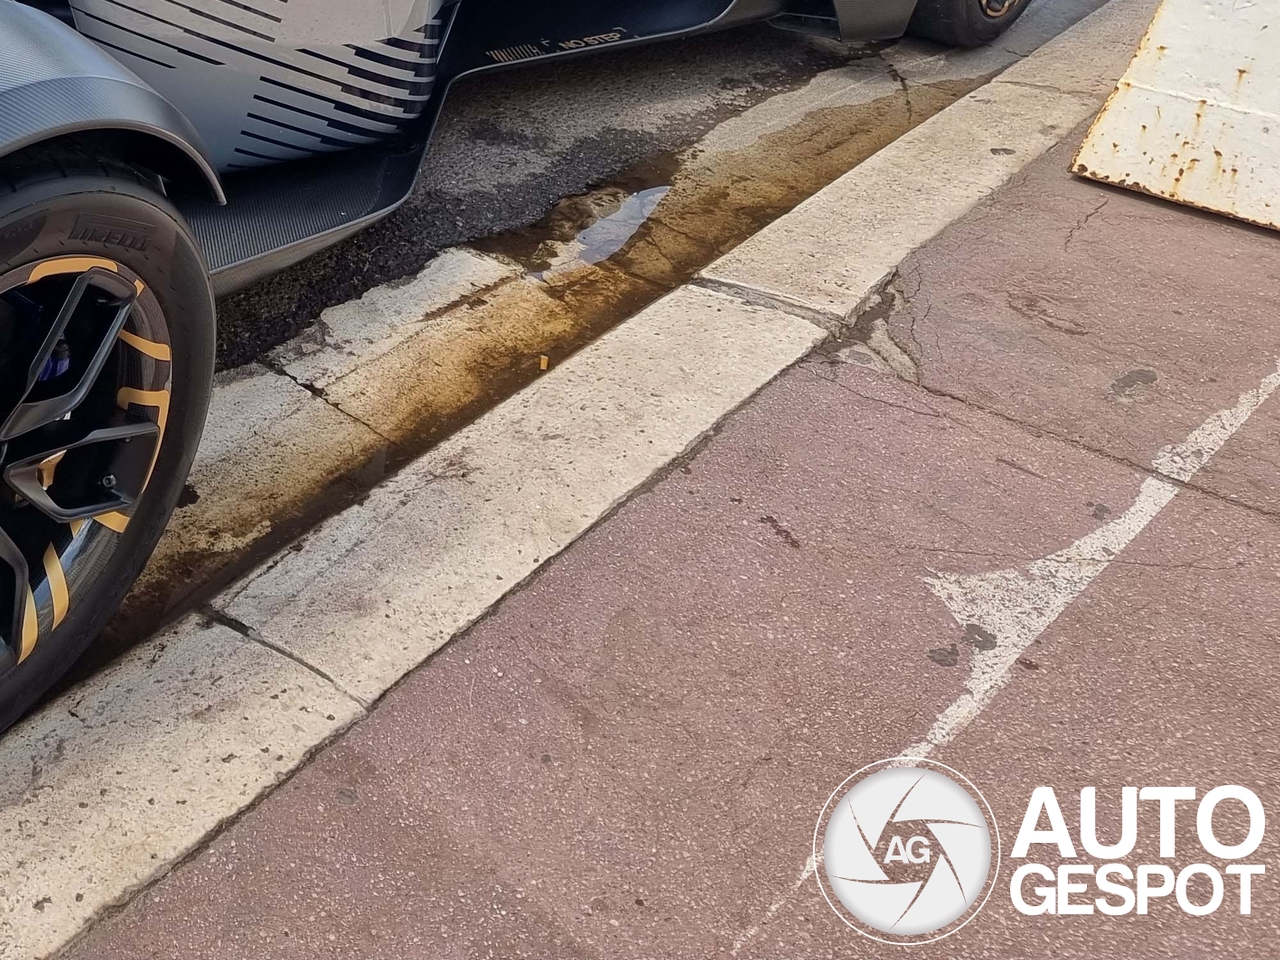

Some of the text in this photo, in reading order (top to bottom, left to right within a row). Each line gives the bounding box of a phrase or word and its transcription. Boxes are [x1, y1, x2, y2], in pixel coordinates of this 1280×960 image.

[558, 32, 621, 50] NO STEP
[67, 212, 157, 253] PIRELLI
